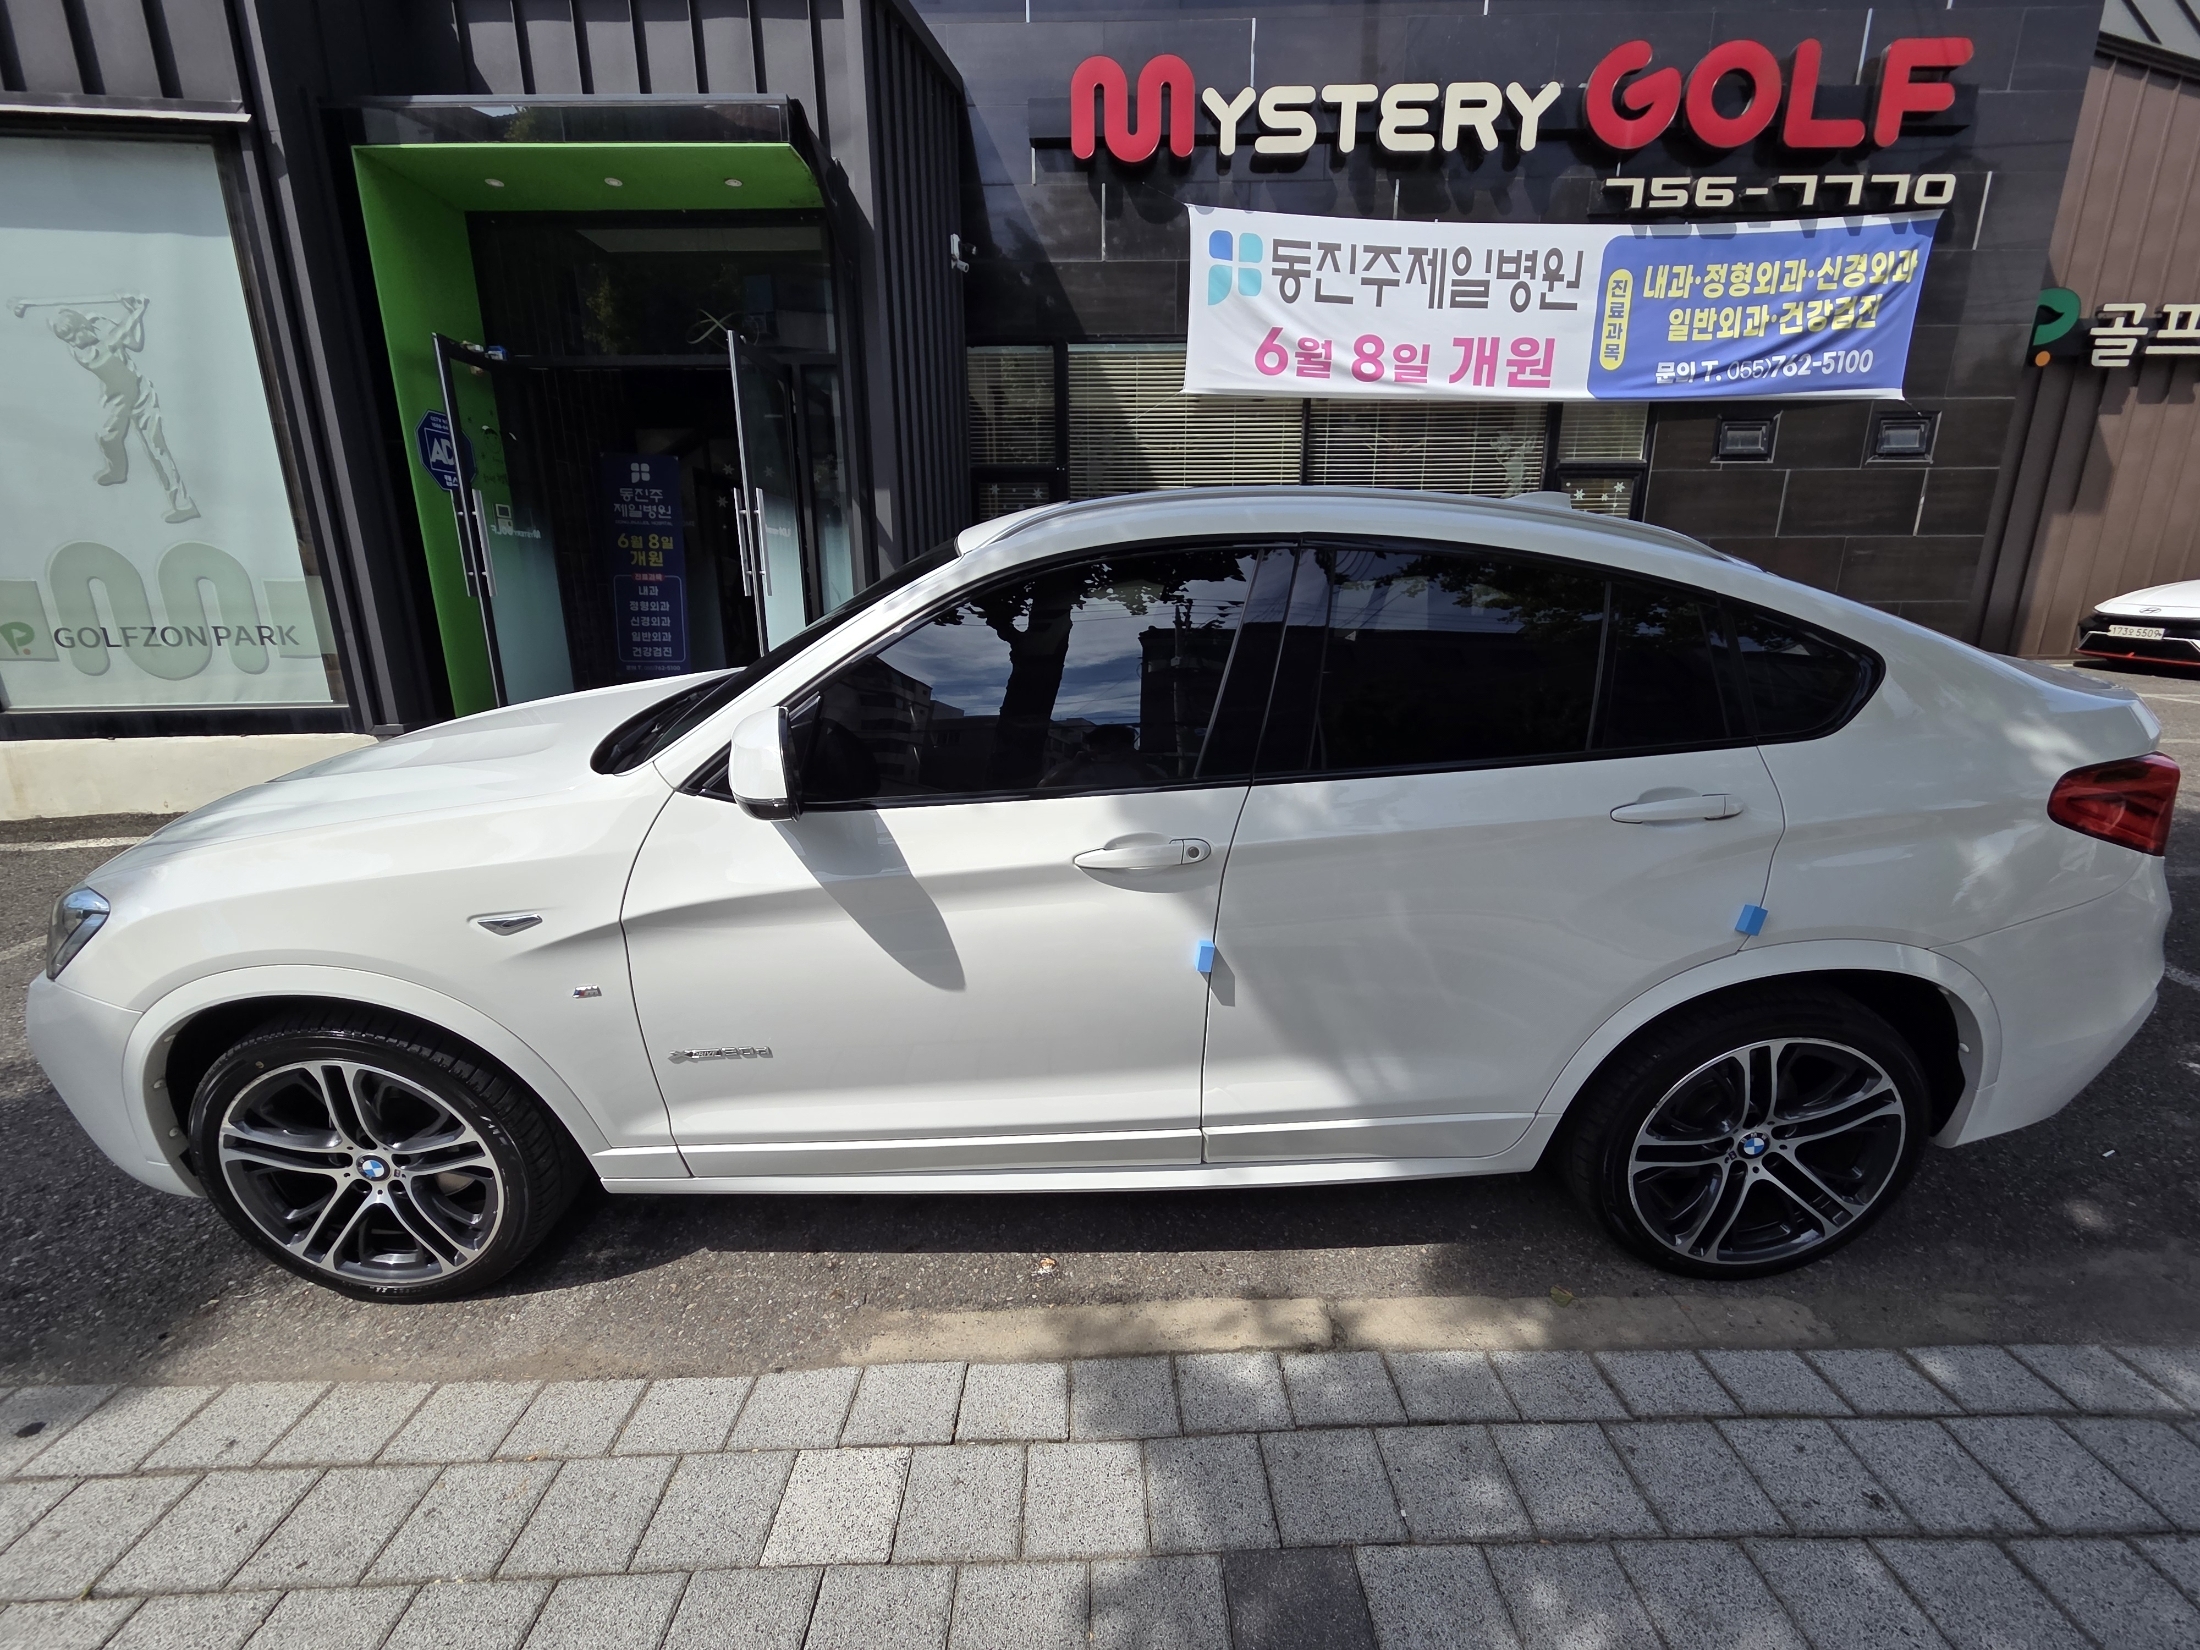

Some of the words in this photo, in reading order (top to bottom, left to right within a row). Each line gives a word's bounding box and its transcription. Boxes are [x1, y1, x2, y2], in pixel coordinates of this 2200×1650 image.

[1070, 53, 1561, 163] MYSTERY
[1586, 37, 1973, 150] GOLF
[1605, 173, 1956, 208] 756-7770
[1271, 238, 1584, 313] 동진주제일병원
[1604, 279, 1628, 361] 진료과목
[1254, 326, 1333, 379] 6월
[1351, 334, 1431, 384] 8일
[1448, 336, 1556, 388] 개원
[1655, 360, 1696, 385] 문의
[431, 438, 455, 466] AD
[619, 488, 663, 503] 동진주
[613, 503, 672, 519] 제일병원
[617, 533, 643, 549] 6월
[648, 533, 674, 549] 8일
[630, 550, 664, 567] 개원
[638, 585, 659, 596] 내과
[629, 600, 670, 611] 정형외과
[630, 616, 671, 627] 신경외과
[631, 631, 672, 642] 일반외과
[632, 646, 672, 657] 건강검진
